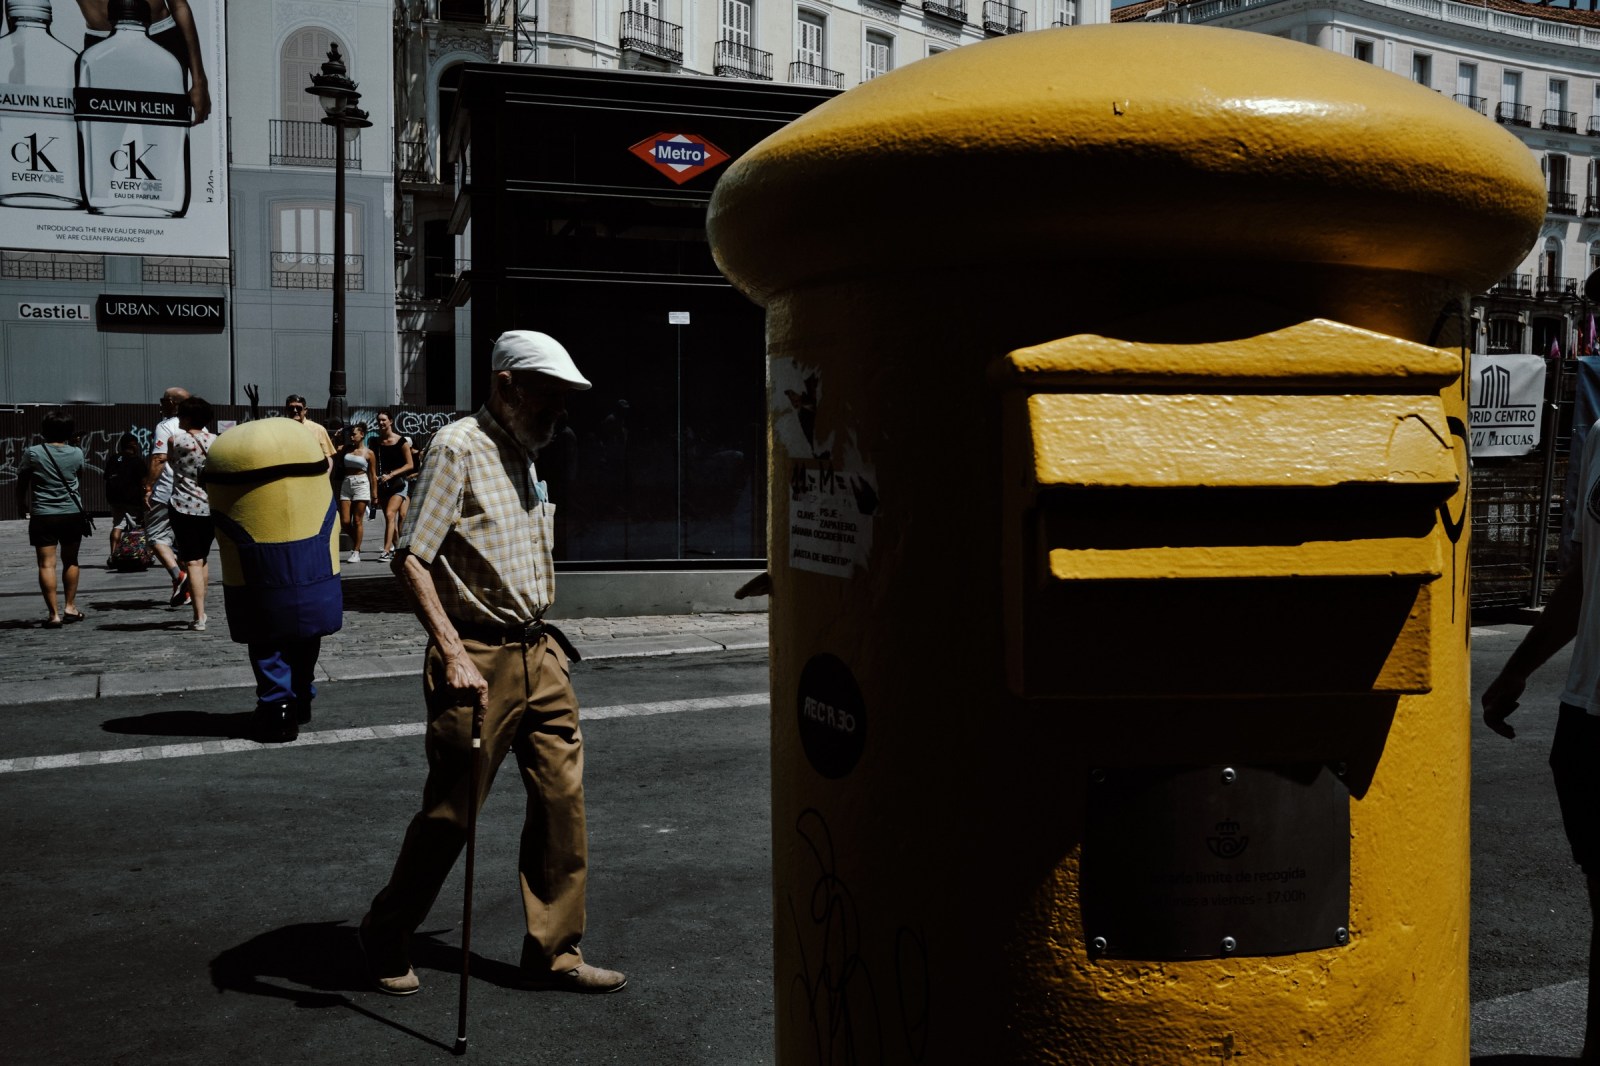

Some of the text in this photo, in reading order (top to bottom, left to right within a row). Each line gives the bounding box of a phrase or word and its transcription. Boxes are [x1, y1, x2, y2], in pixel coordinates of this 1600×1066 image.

[89, 98, 175, 115] CALVIN KLEIN
[658, 145, 702, 161] Metro
[12, 173, 64, 184] EVERYONE
[110, 180, 162, 191] EVERYONE
[36, 224, 84, 233] INTRODUCING
[138, 228, 164, 236] PARFUM
[105, 302, 220, 317] URBAN VISION
[1494, 410, 1536, 422] CENTRO
[1235, 869, 1251, 882] de
[1253, 866, 1306, 883] recogida
